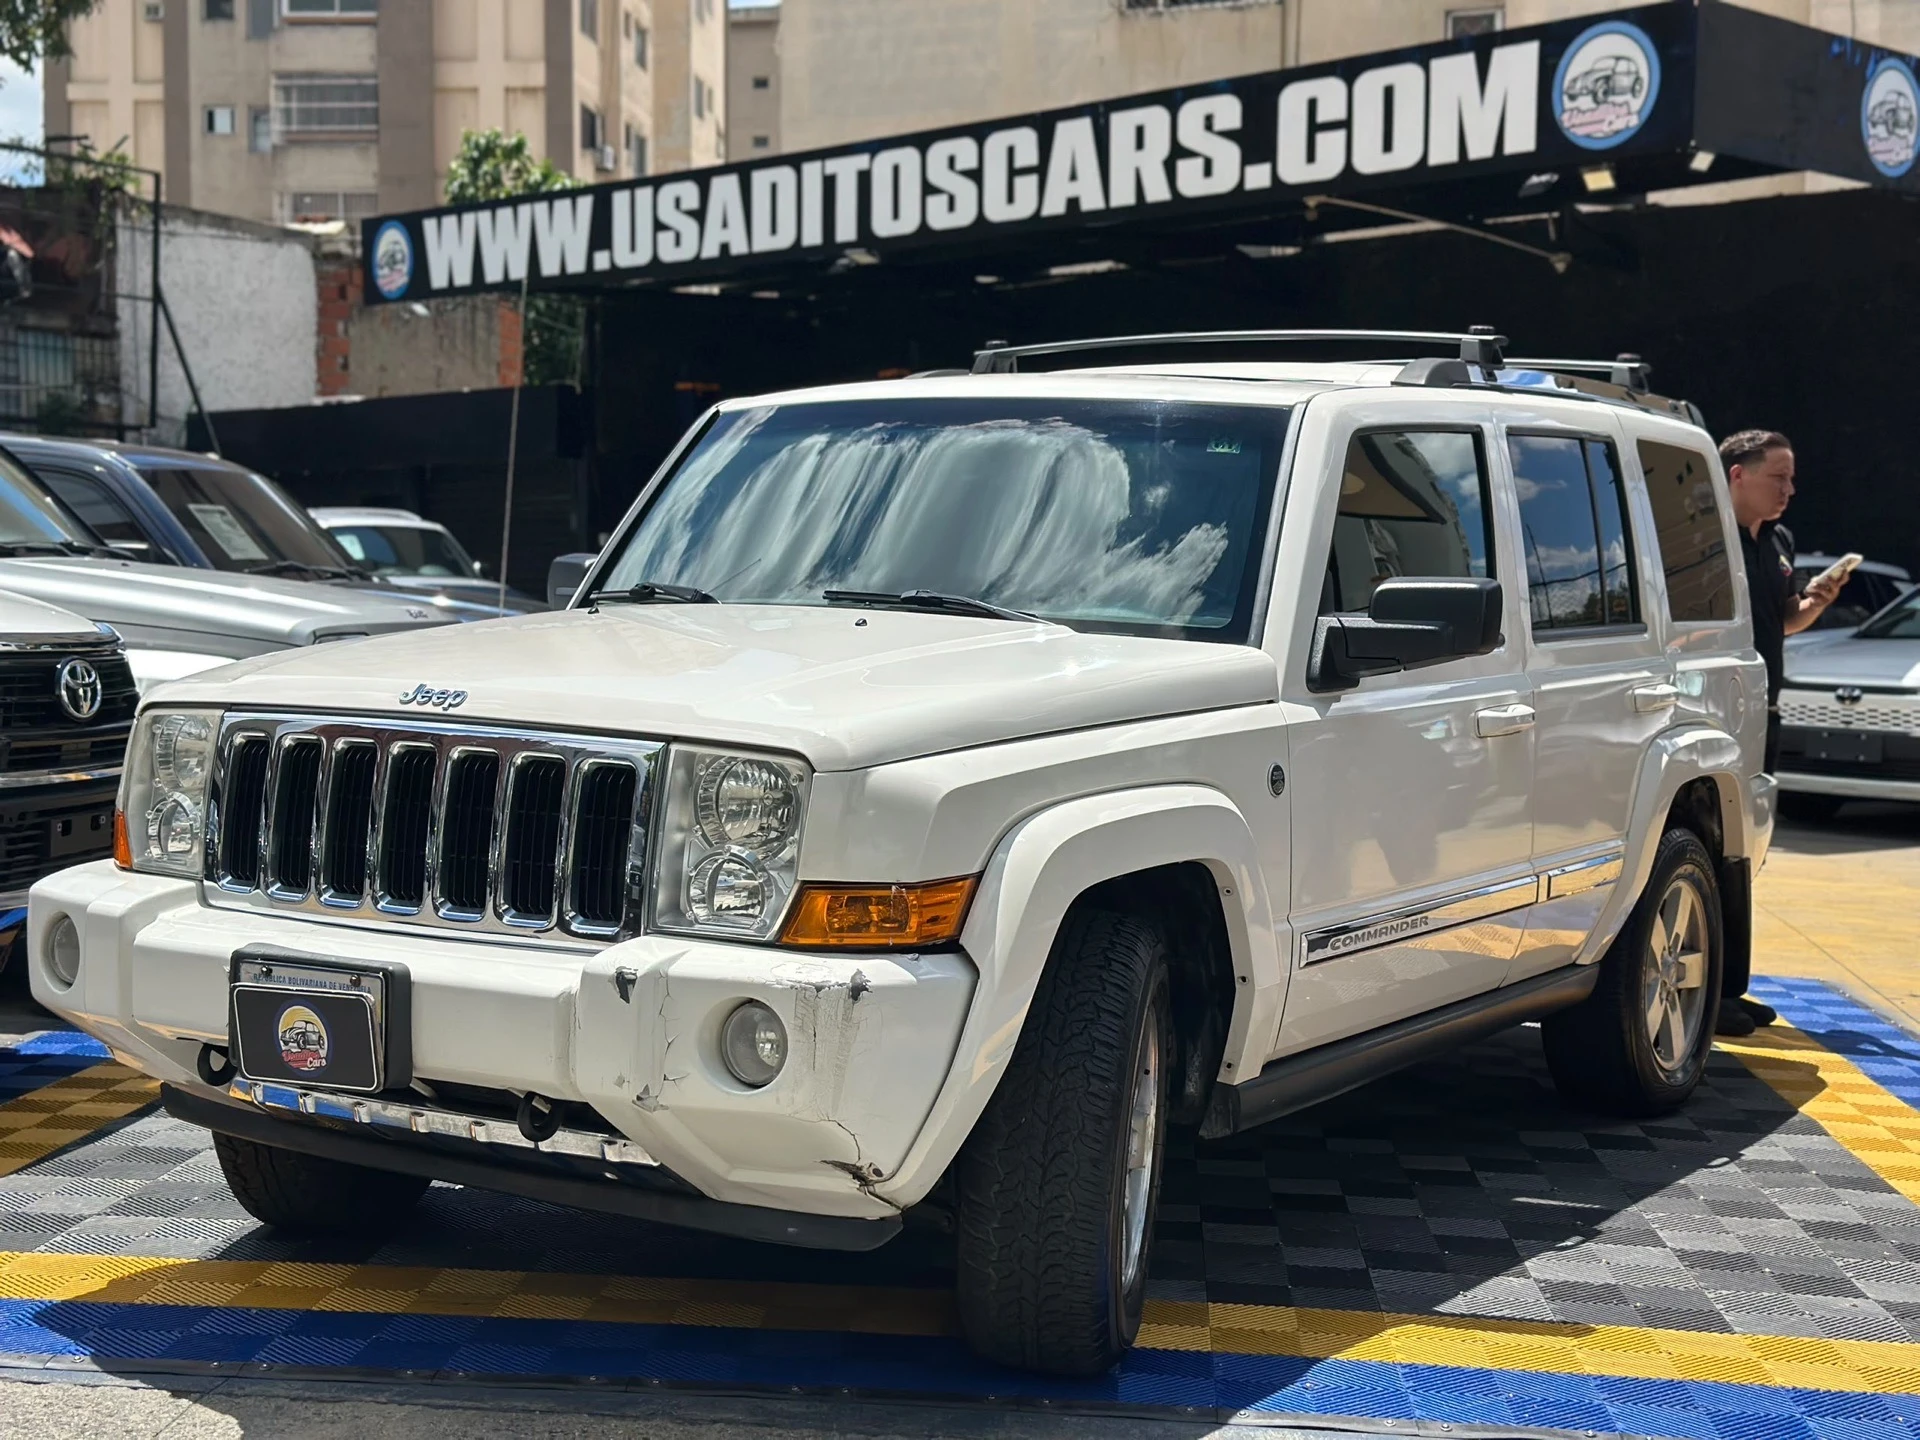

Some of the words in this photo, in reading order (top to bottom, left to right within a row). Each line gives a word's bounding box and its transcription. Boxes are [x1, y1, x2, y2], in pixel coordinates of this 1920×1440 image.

[423, 41, 1540, 289] WWW.USADITOSCARS.COM
[399, 683, 468, 712] Jeep
[1330, 915, 1429, 951] COMMANDER
[288, 976, 327, 988] BOLIVARIANA
[328, 983, 338, 991] DE
